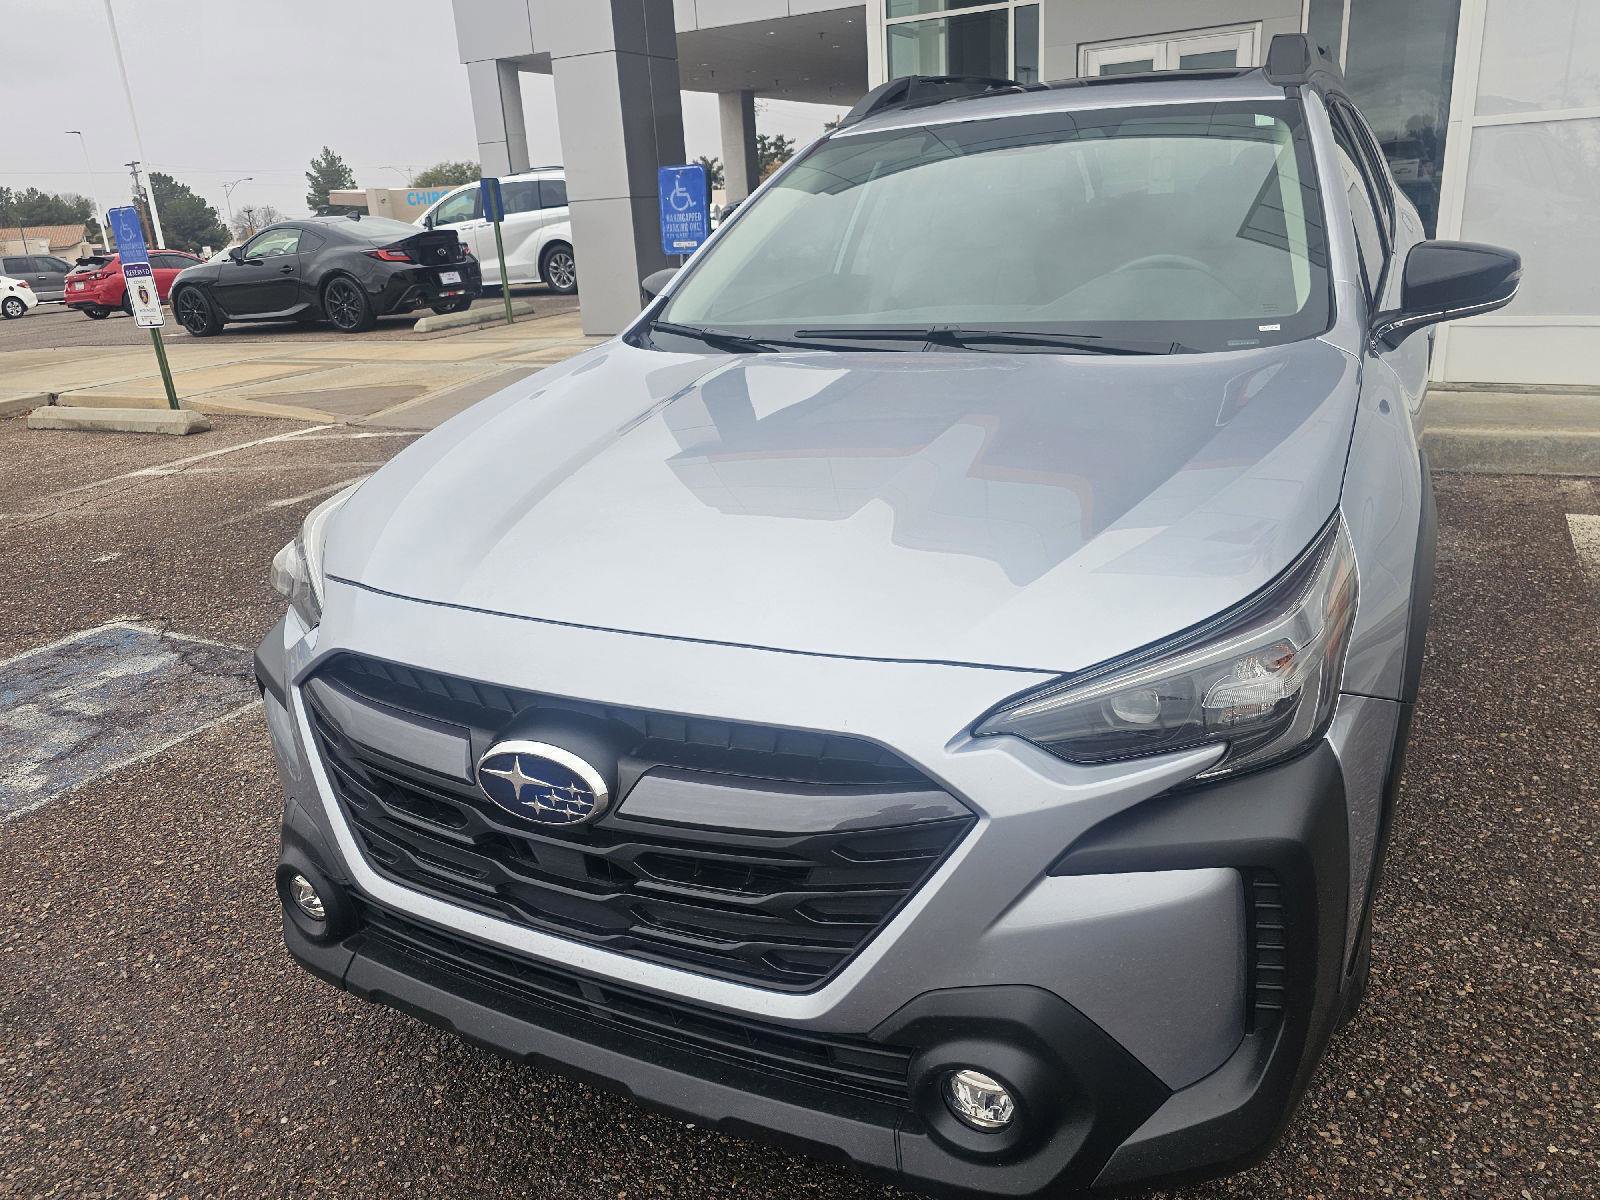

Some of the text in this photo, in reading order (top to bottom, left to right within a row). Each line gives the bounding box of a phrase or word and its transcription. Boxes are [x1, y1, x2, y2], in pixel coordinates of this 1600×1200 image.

[666, 212, 702, 223] HANDICAPPED
[666, 222, 703, 232] PARKING ONLY
[126, 268, 150, 278] RESERVED
